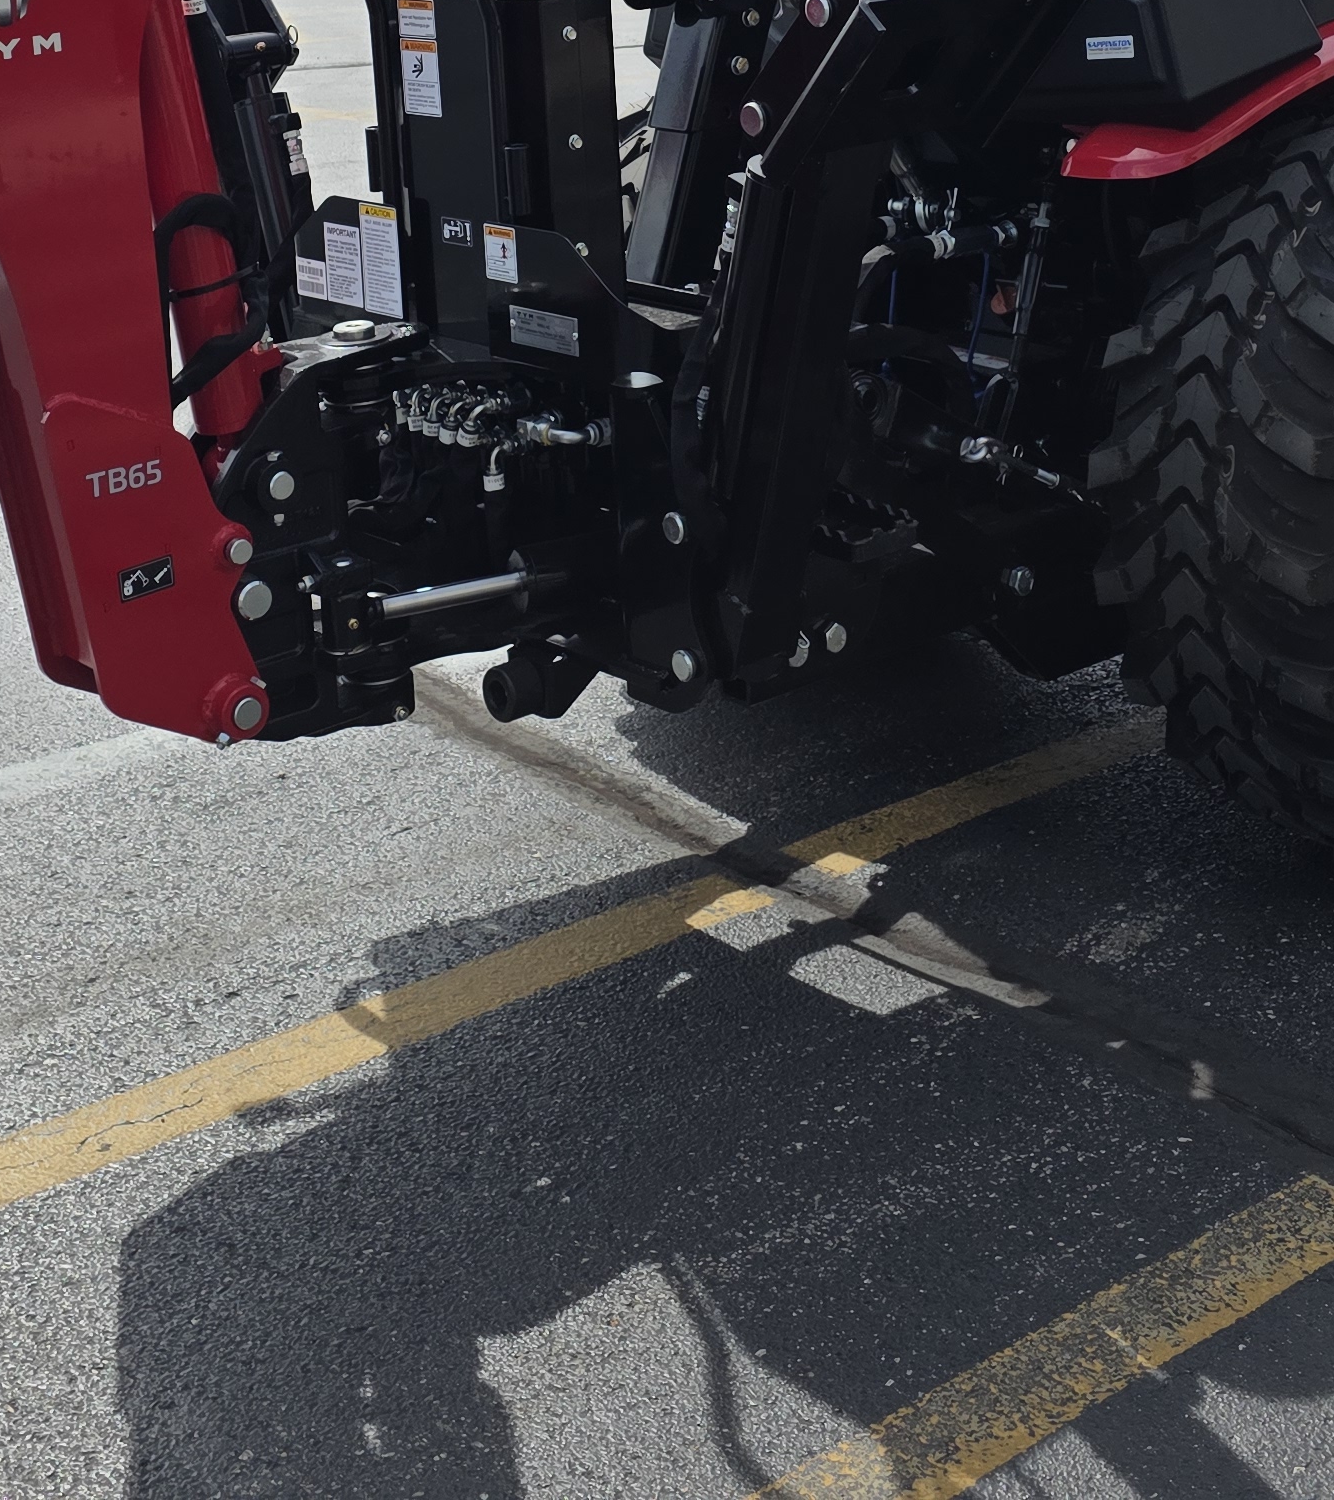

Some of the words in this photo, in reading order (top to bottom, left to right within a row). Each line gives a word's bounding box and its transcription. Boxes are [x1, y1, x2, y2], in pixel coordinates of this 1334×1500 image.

[1088, 40, 1131, 48] SAPPINGTON
[370, 208, 391, 219] CAUTION
[327, 227, 357, 239] IMPORTANT
[85, 459, 162, 498] TB65
